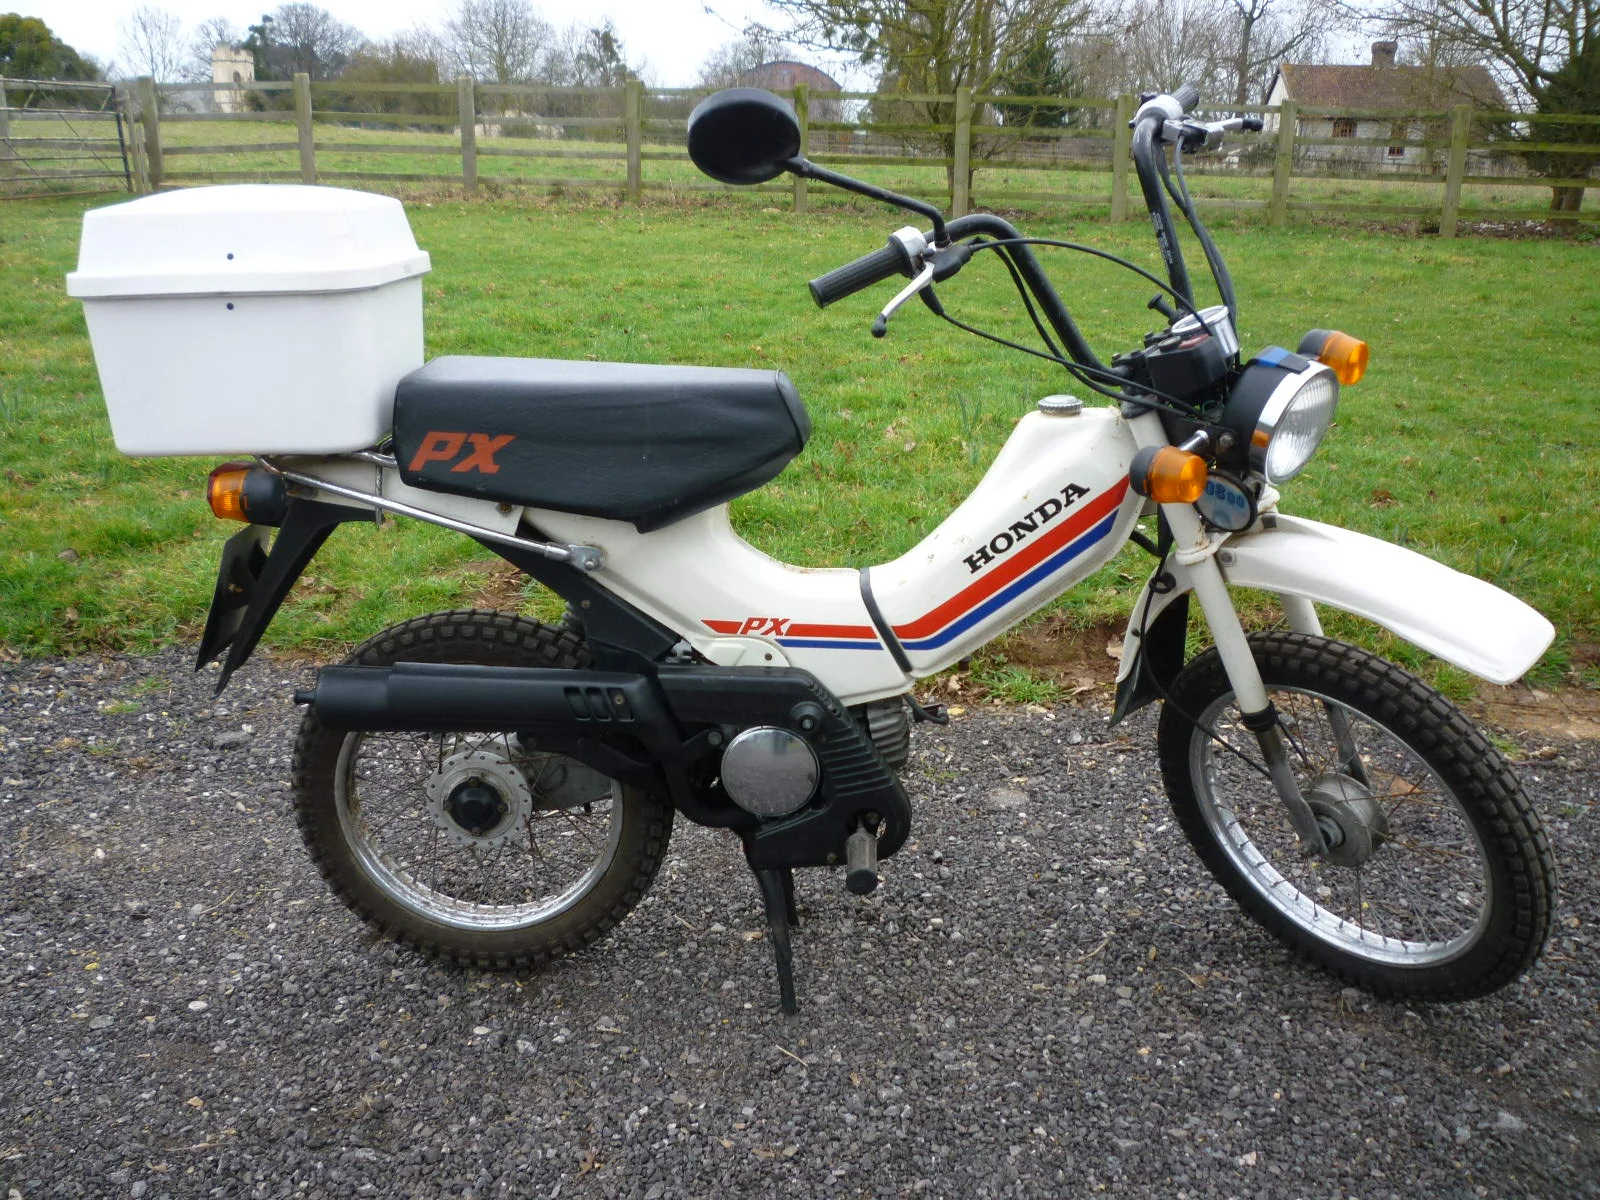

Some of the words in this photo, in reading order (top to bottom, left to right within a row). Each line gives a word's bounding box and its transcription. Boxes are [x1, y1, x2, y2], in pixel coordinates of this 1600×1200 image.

[408, 431, 515, 475] PX
[963, 483, 1091, 574] HONDA
[740, 617, 791, 636] PX
